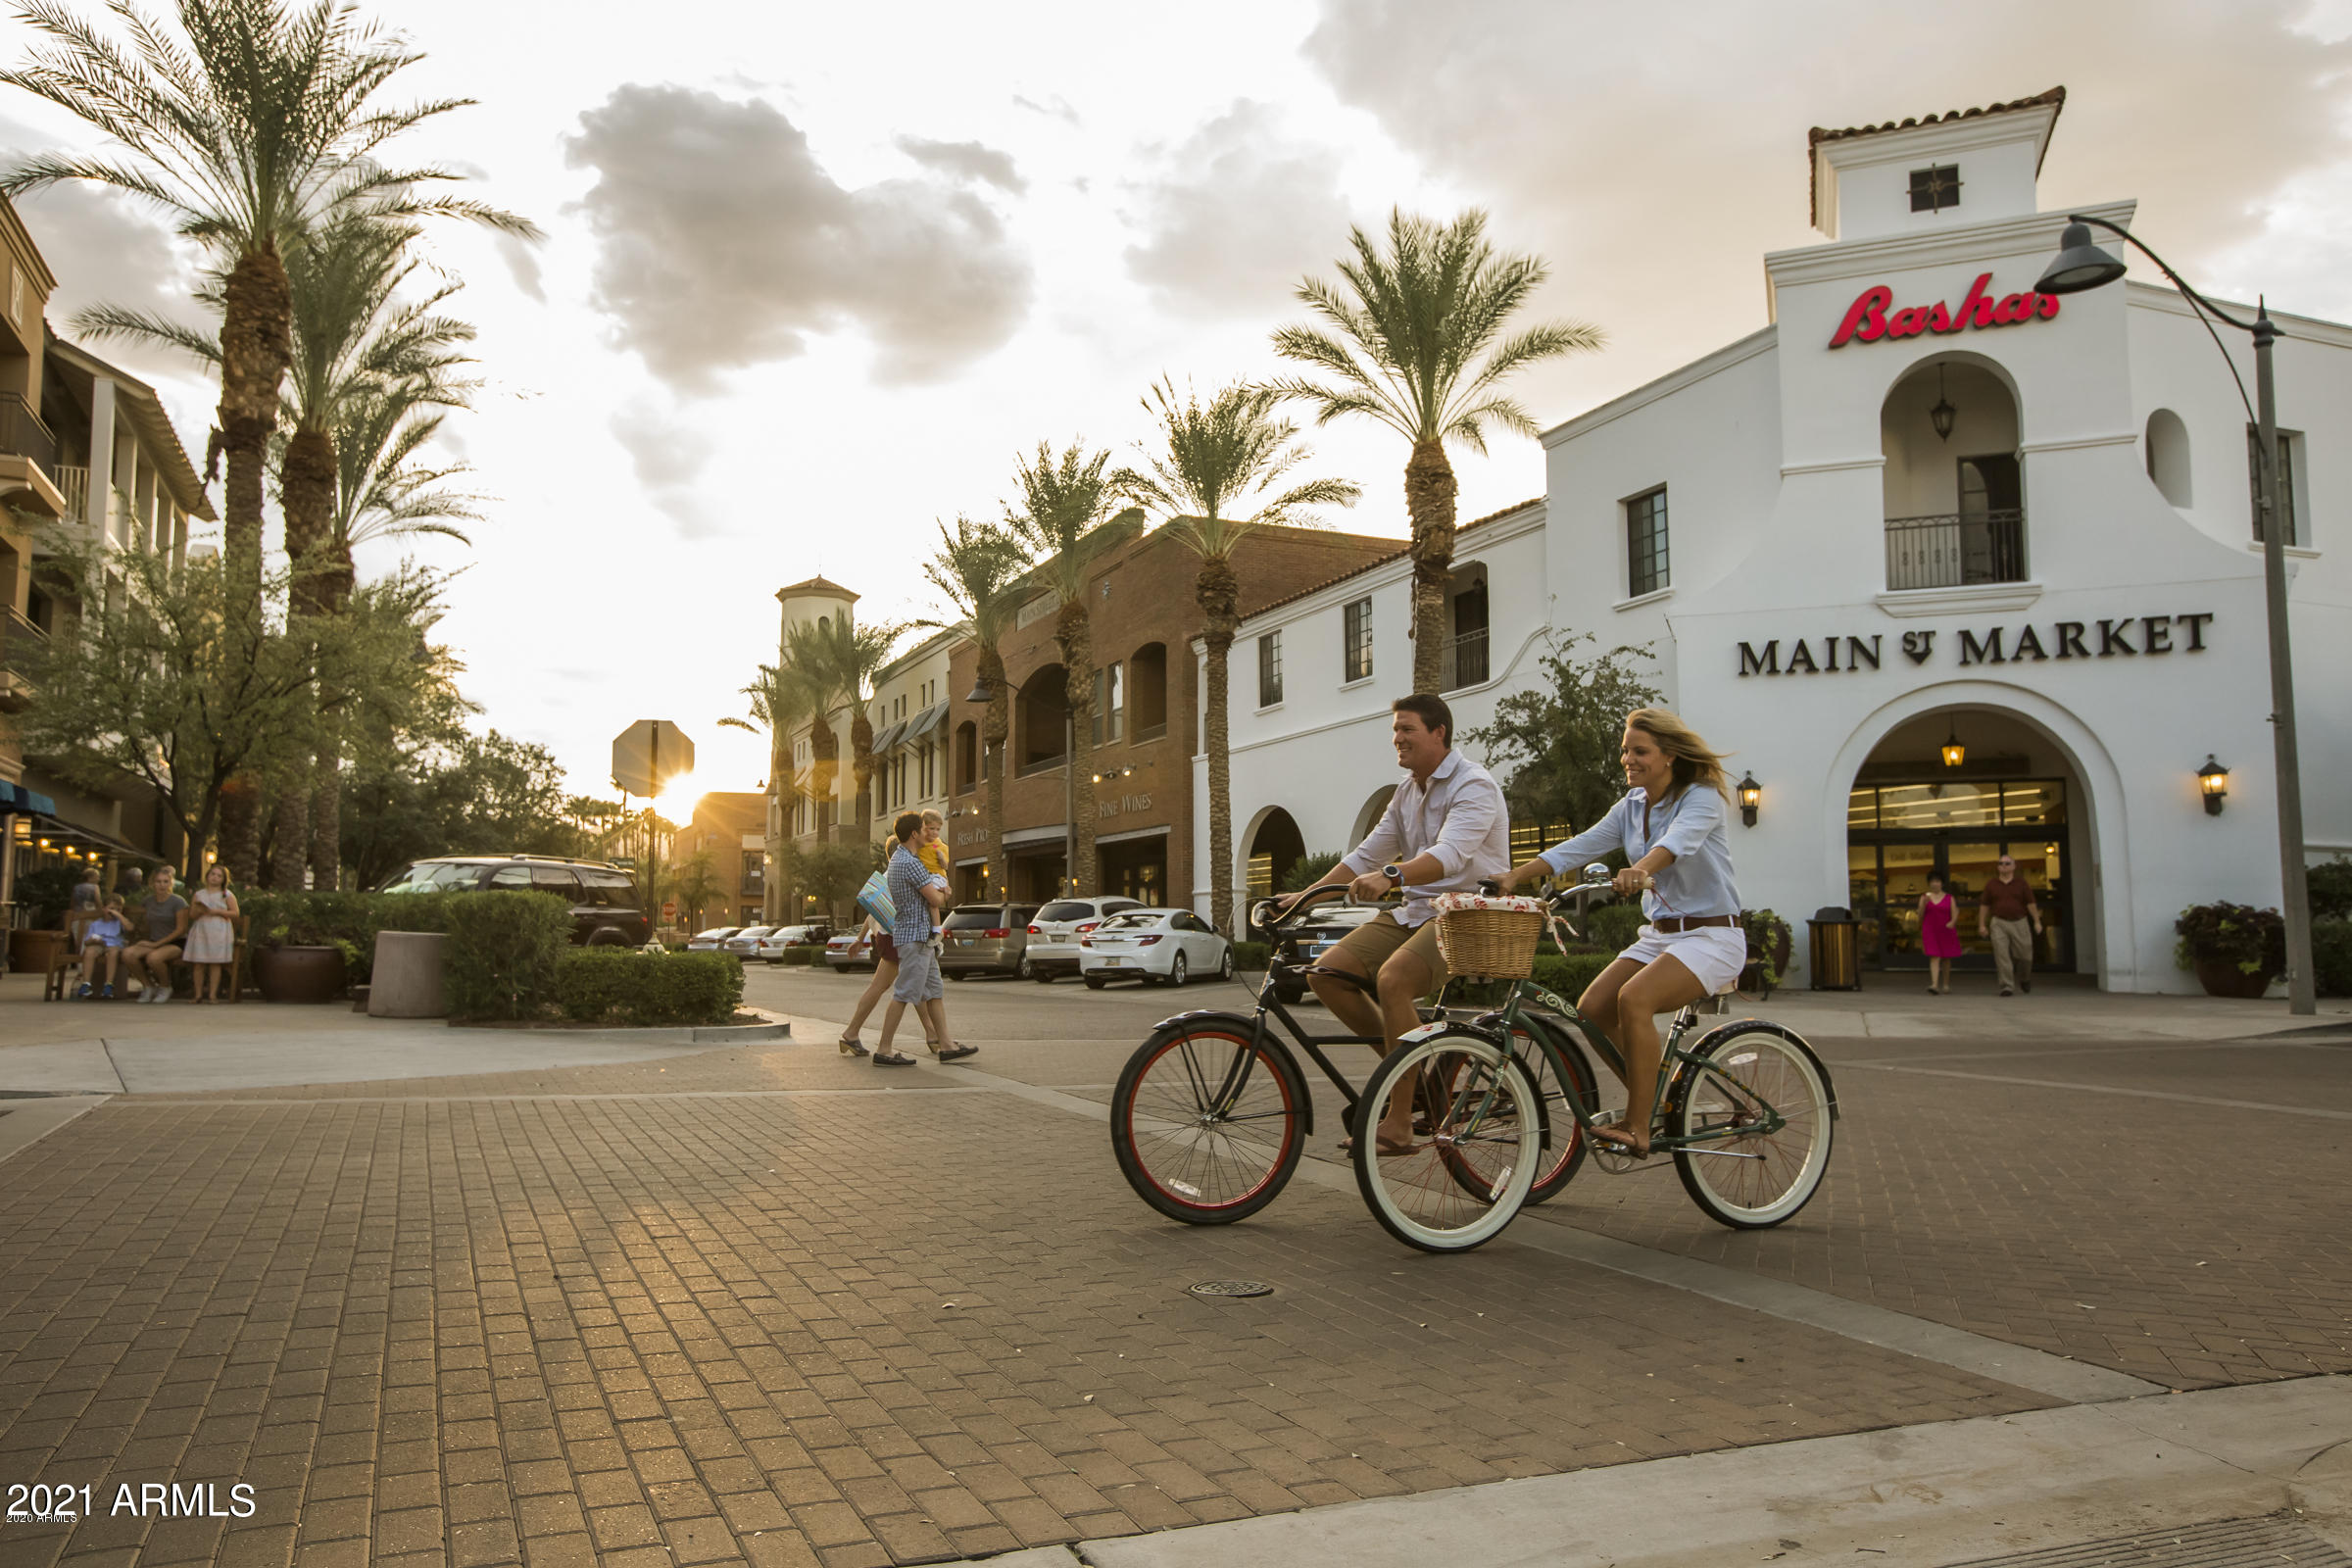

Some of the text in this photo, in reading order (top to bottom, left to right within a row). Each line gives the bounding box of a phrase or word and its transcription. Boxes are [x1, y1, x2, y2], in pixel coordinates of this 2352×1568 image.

[1738, 612, 2214, 676] MAIN ST MARKET
[1099, 793, 1152, 818] FINE WINES
